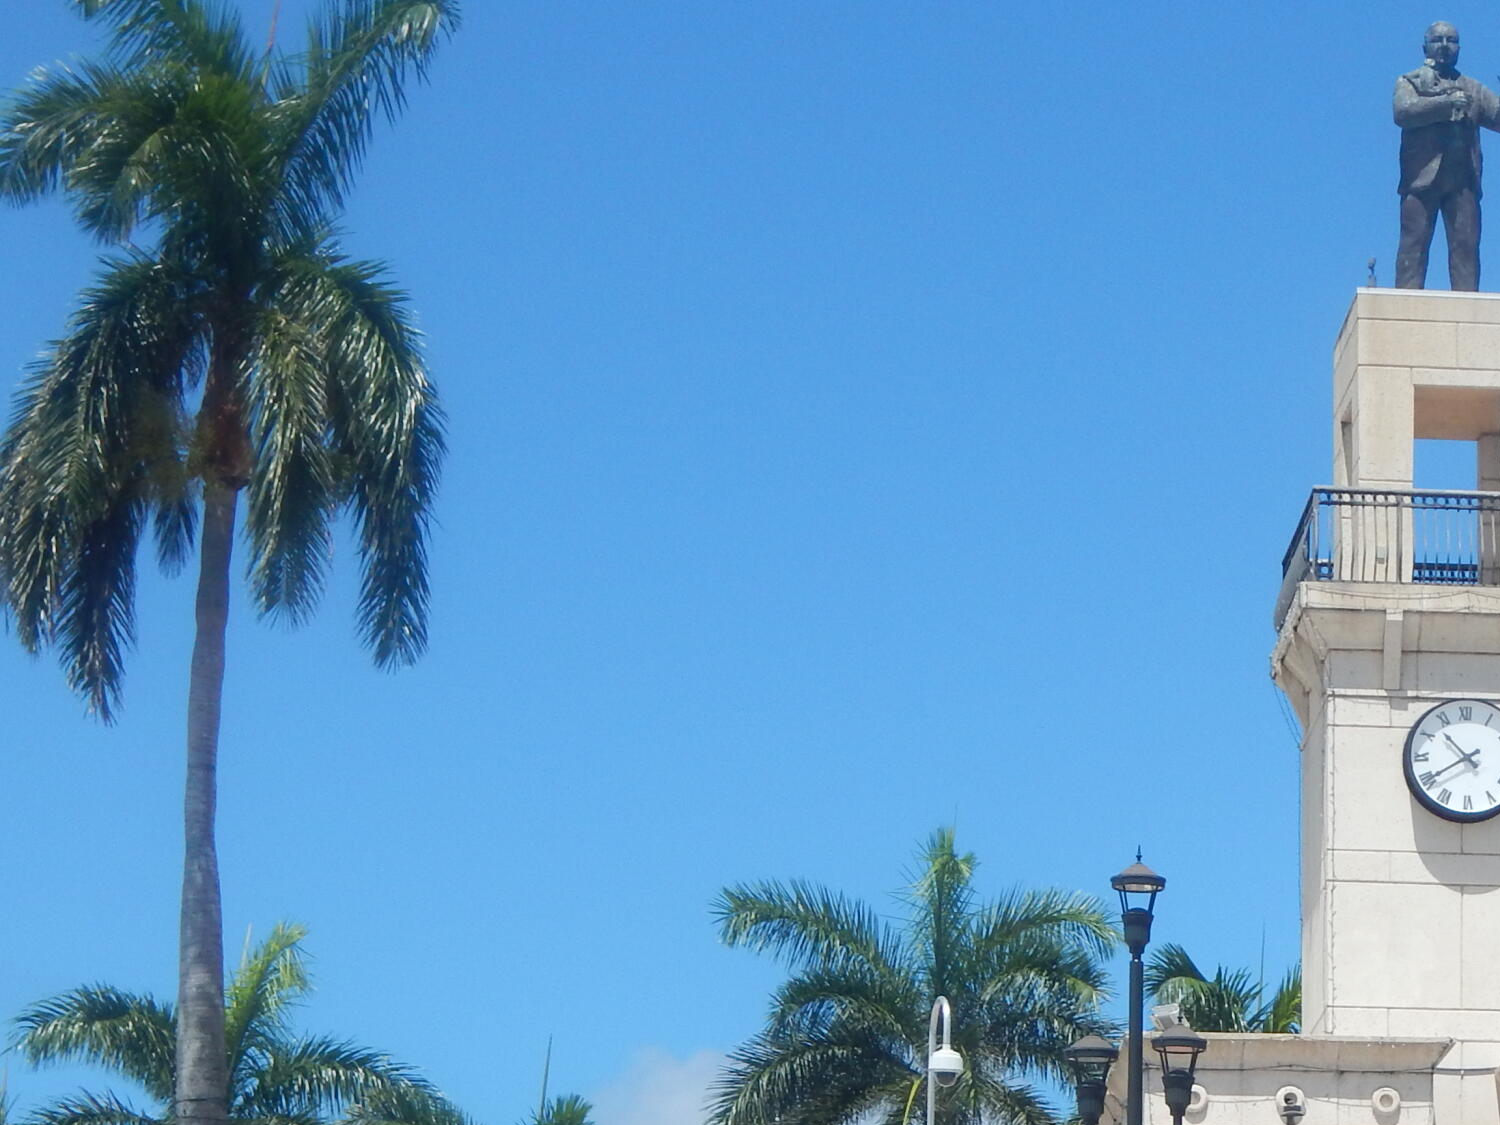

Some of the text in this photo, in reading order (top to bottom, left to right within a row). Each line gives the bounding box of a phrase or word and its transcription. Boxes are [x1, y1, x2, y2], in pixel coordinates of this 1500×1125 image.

[1436, 711, 1451, 727] XI
[1458, 706, 1472, 721] XII
[1420, 729, 1435, 742] X
[1463, 795, 1473, 810] VI
[1485, 790, 1497, 805] V
